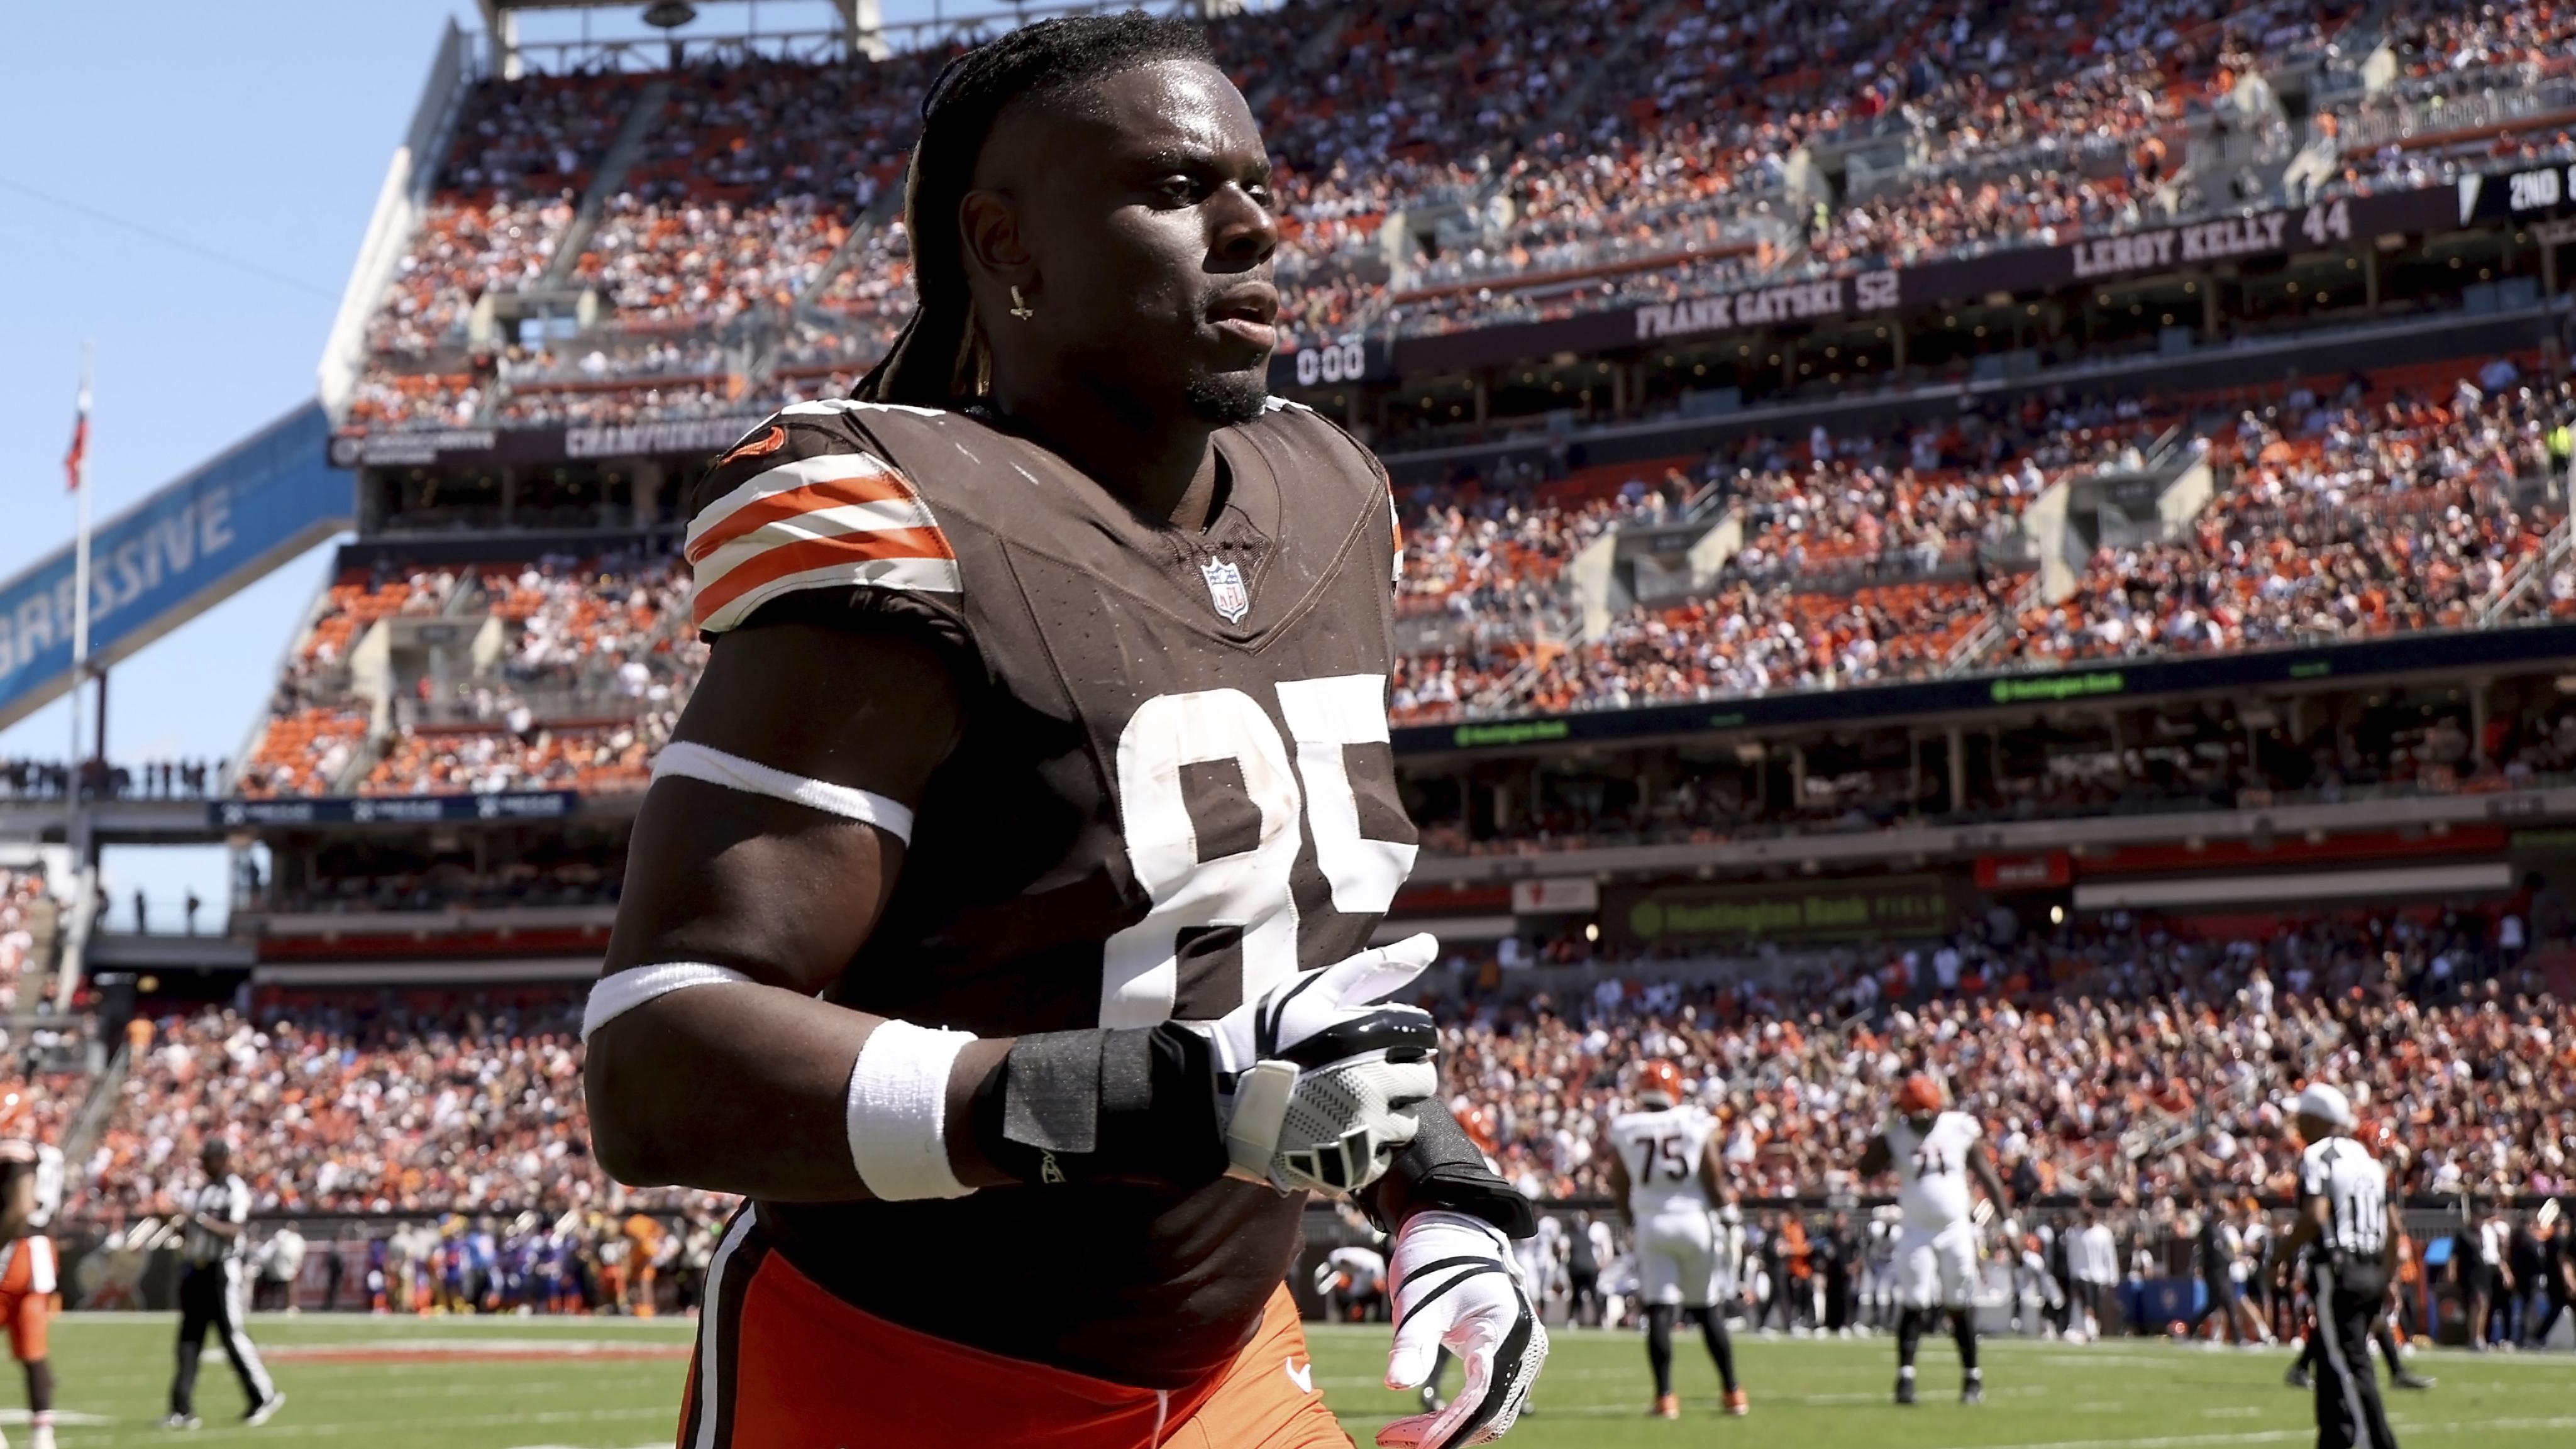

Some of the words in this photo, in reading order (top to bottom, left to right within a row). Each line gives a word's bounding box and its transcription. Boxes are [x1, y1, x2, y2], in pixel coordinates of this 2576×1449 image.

[2509, 168, 2561, 211] 2ND
[2072, 230, 2175, 277] LEROY
[2180, 211, 2287, 262] KELLY
[2301, 199, 2351, 244] 44
[1636, 297, 1732, 340] FRANK
[1735, 280, 1842, 326] GATSKI
[1855, 270, 1899, 312] 52
[1296, 344, 1364, 386] 0:00
[1098, 674, 1420, 1030] 85
[1634, 1133, 1689, 1186] 75
